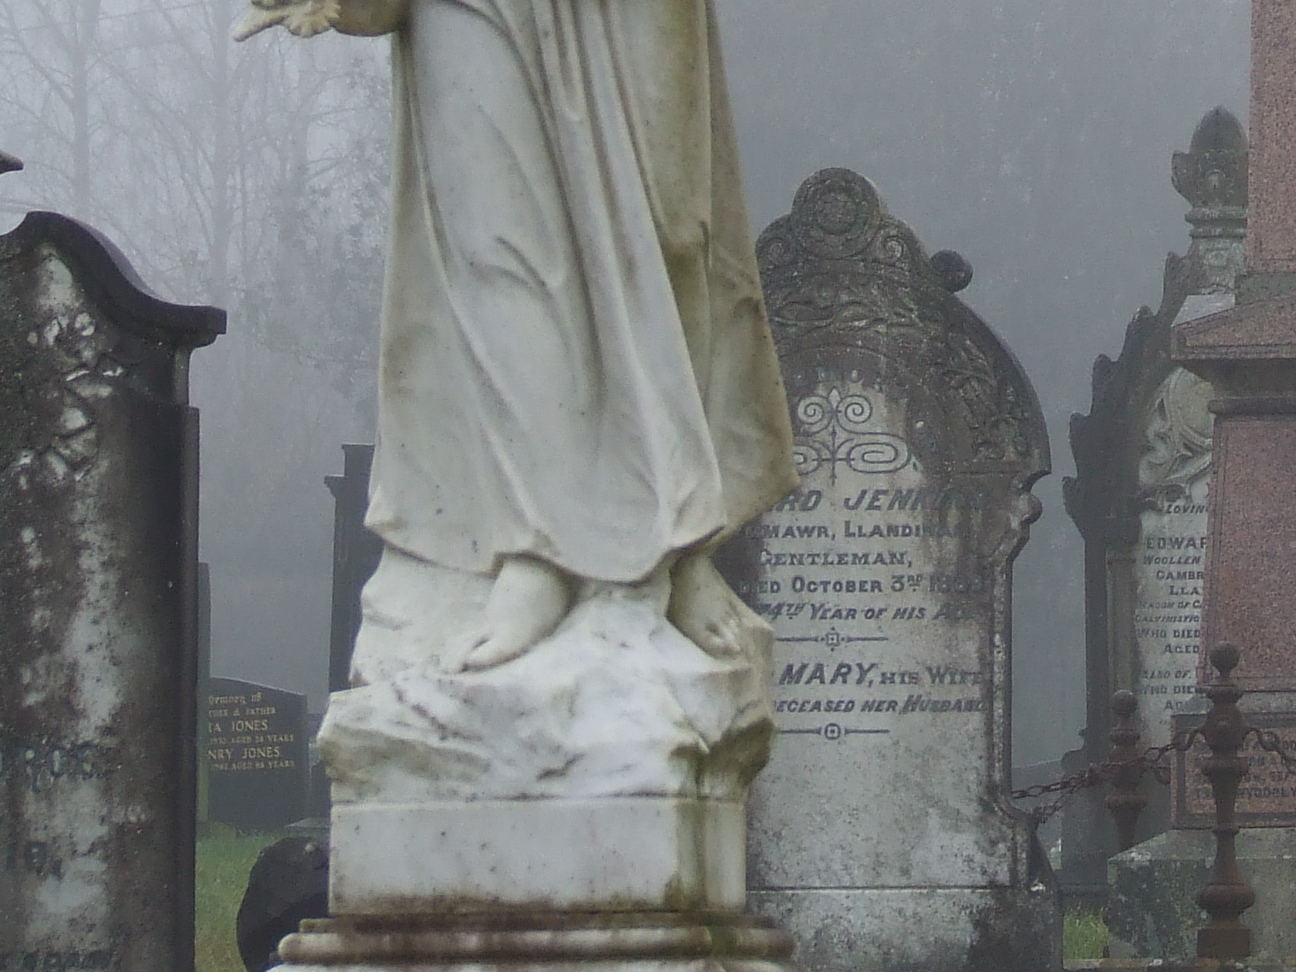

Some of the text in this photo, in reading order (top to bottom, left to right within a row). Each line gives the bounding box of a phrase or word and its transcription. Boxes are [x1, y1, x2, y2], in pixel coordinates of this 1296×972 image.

[771, 488, 823, 511] RD
[1165, 503, 1208, 515] LOVIN
[758, 549, 913, 568] GENTLEMAN,
[791, 577, 884, 595] OCTOBER
[808, 602, 864, 621] YEAR
[864, 606, 888, 620] OF
[892, 606, 927, 620] HIS
[1173, 629, 1200, 639] DIED
[1163, 644, 1200, 654] AGED
[778, 662, 985, 689] MARY, HIS WIFE
[245, 706, 277, 716] FATHER
[774, 698, 856, 713] ECEASED
[860, 699, 899, 713] HER
[241, 746, 281, 759] JONES
